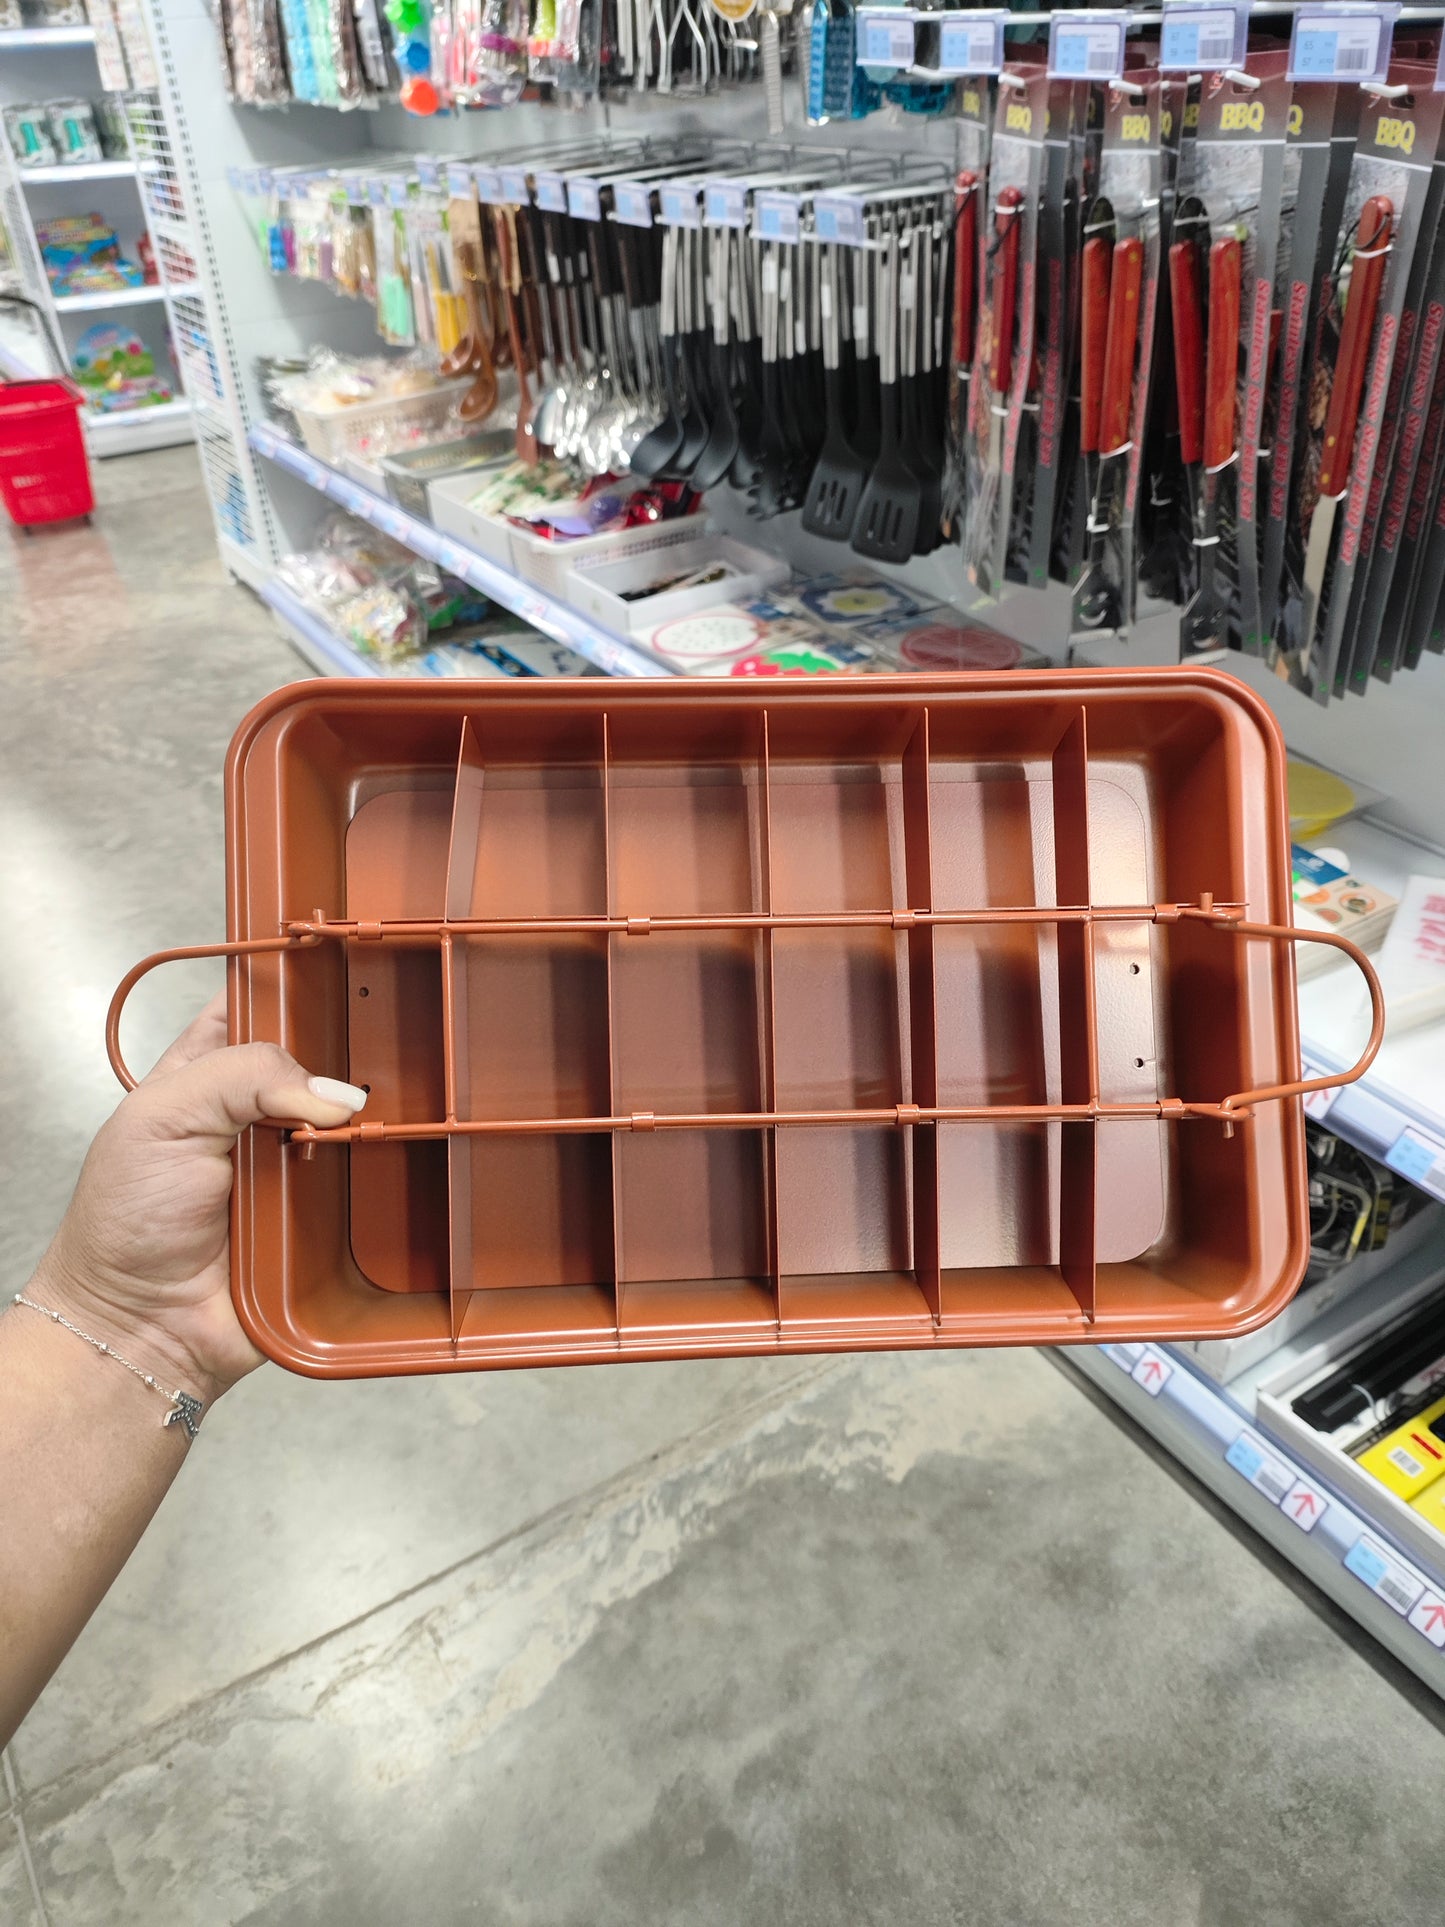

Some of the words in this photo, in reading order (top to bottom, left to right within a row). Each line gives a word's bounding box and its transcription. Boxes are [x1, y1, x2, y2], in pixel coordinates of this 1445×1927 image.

[1005, 104, 1032, 135] BBQ
[1121, 114, 1150, 144] BBQ
[1219, 101, 1265, 133] BBQ
[1374, 116, 1416, 155] BBQ
[1283, 279, 1308, 384] Stainless
[1410, 301, 1445, 410] Stainless
[1366, 312, 1397, 422] Stainless
[1354, 422, 1377, 484] Steel
